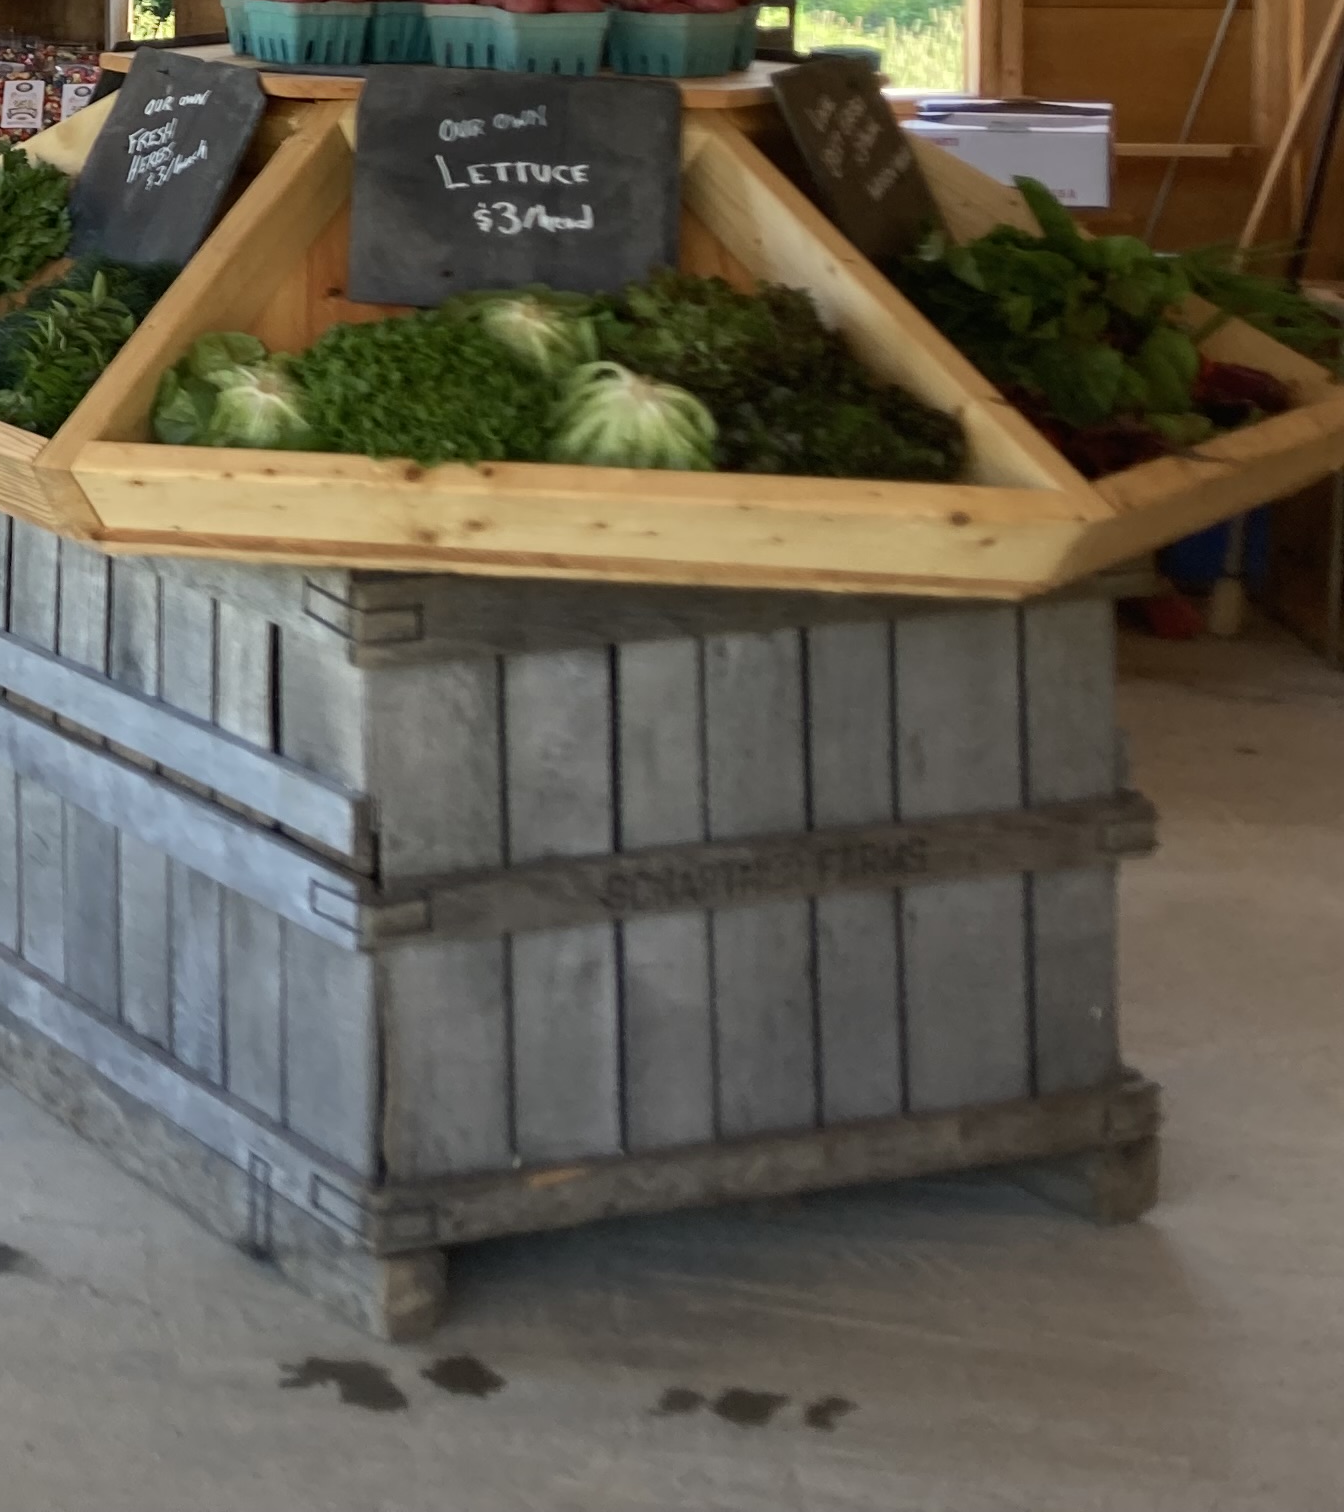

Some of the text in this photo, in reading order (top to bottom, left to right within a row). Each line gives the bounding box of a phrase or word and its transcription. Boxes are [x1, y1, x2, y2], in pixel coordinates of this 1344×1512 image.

[144, 90, 212, 115] OUR OWN
[128, 118, 179, 154] FRESH
[438, 104, 548, 142] OUR OWN
[126, 142, 177, 183] HERBS
[434, 154, 590, 189] LETTUCE
